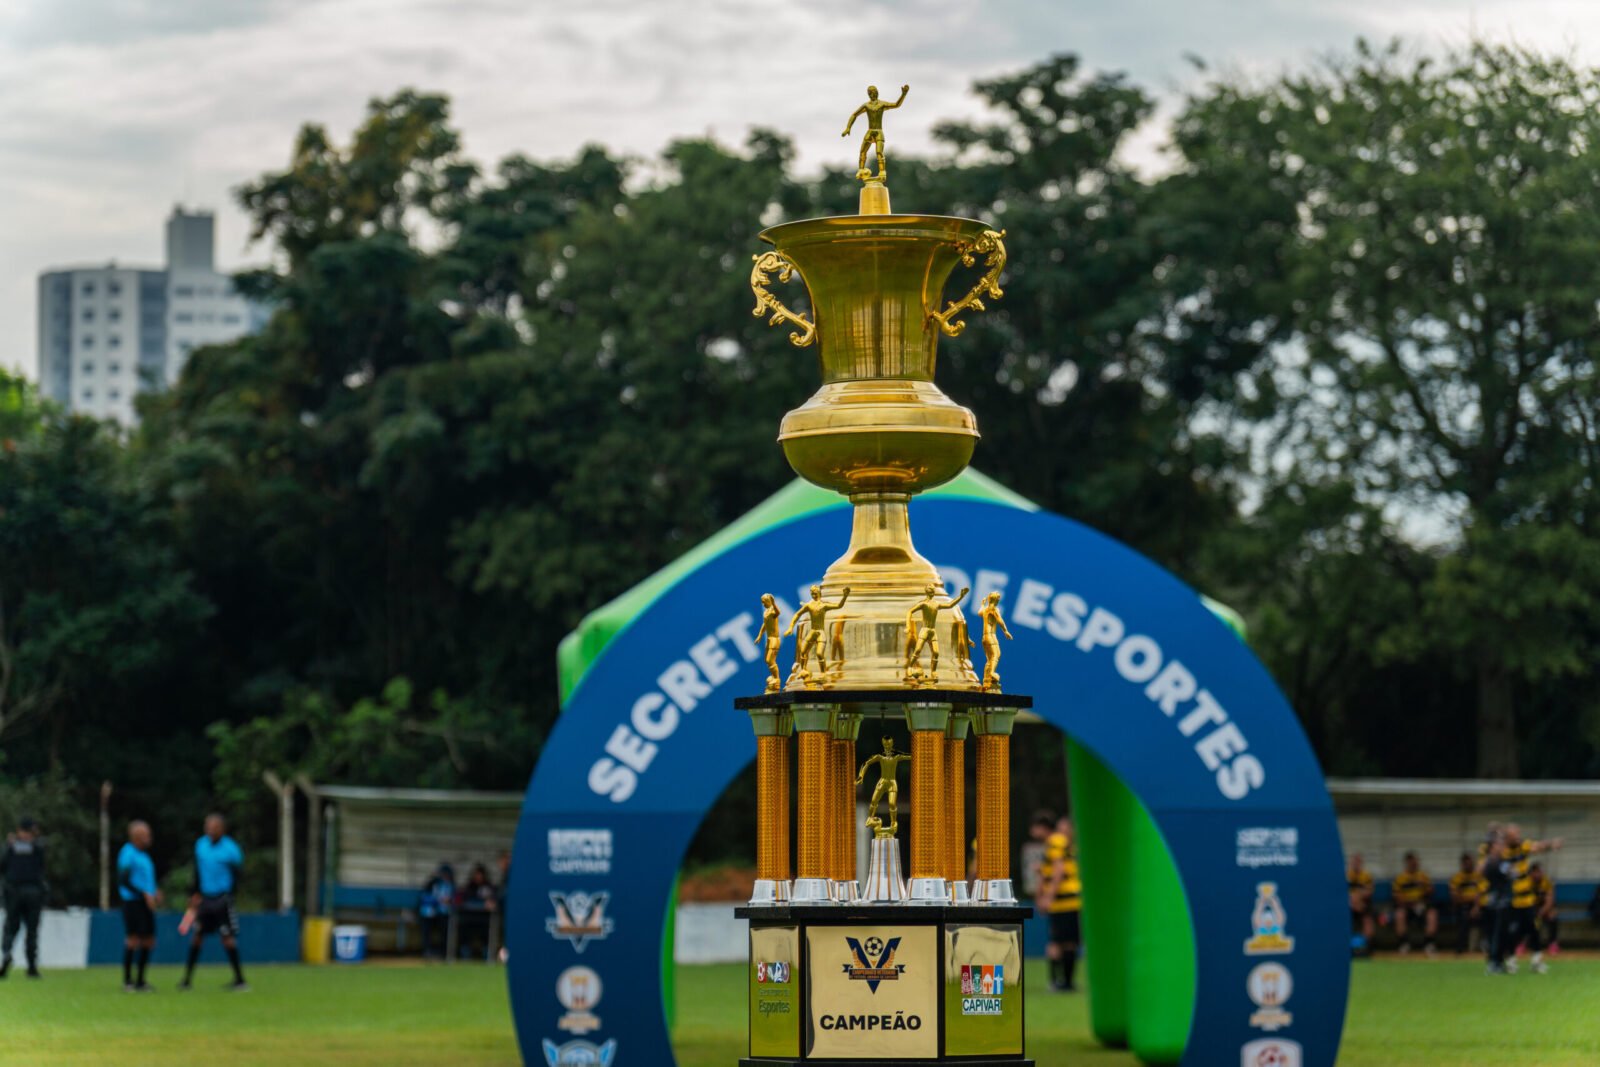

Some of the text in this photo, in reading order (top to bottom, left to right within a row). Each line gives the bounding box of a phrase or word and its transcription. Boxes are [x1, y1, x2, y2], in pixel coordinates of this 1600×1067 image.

[1011, 577, 1265, 800] ESPORTES
[759, 1000, 790, 1017] Esportes
[962, 998, 1003, 1012] CAPIVARI
[820, 1010, 922, 1030] CAMPEÃO
